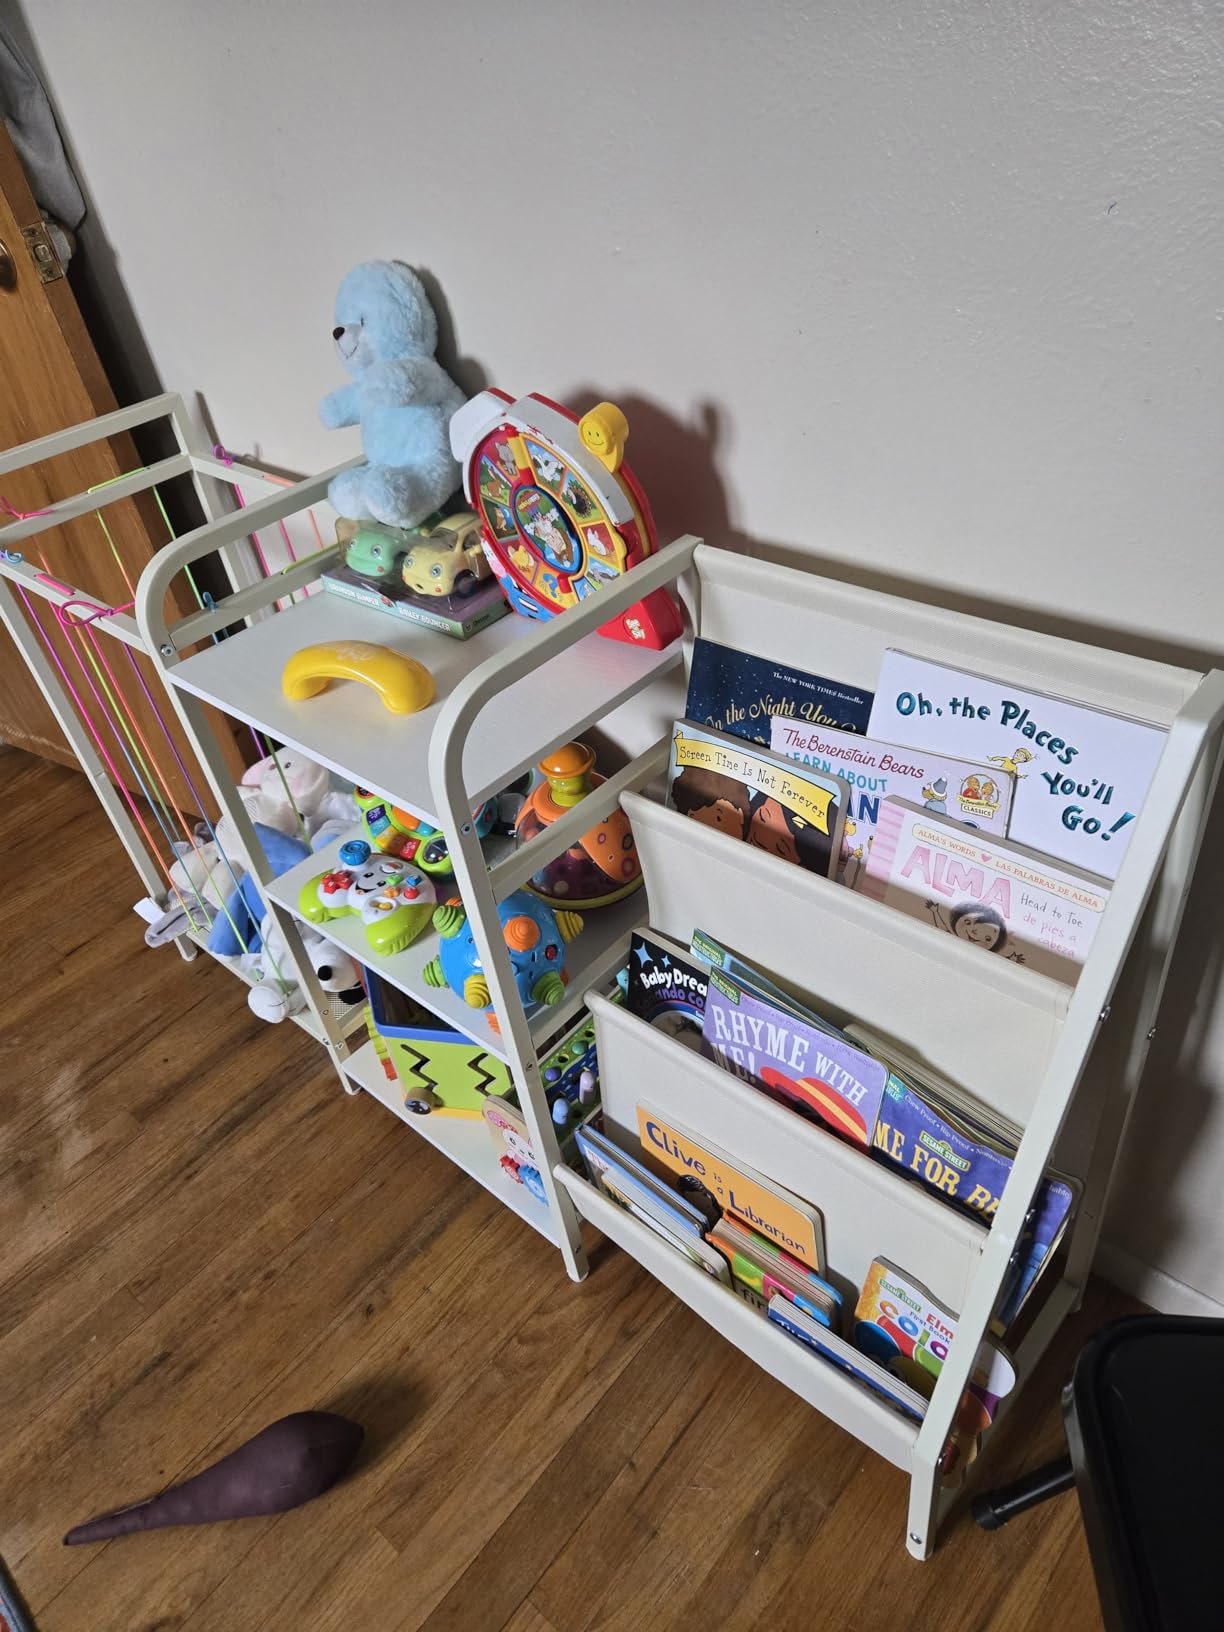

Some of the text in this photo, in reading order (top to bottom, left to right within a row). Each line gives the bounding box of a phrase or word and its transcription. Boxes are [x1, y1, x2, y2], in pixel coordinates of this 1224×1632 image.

[784, 674, 797, 684] NEW
[799, 679, 815, 690] YORK
[817, 685, 837, 696] TIMES
[726, 702, 745, 726] the
[749, 694, 796, 718] Night
[896, 691, 1079, 765] Oh, the Places
[783, 728, 925, 779] The Berenstain Bears
[679, 746, 712, 763] Screen
[715, 751, 739, 772] Time
[742, 761, 753, 776] Is
[757, 768, 776, 789] Not
[780, 780, 825, 818] Forever
[785, 752, 888, 792] EARN ABOUT
[1040, 771, 1114, 805] You'll
[963, 805, 991, 817] CLASSICS
[1061, 804, 1136, 841] Go!
[900, 844, 1011, 920] ALMA
[918, 829, 1099, 909] ALMA'S WORDS LAS PALABRAS DE ALMA
[1021, 892, 1084, 928] Head to Toe
[1023, 913, 1077, 943] de pies a
[1037, 936, 1075, 959] cabeza
[640, 965, 672, 990] Baby
[673, 967, 708, 997] Drea
[688, 991, 704, 1009] co
[711, 1004, 810, 1073] RHYME
[815, 1051, 869, 1106] WITH
[646, 1121, 706, 1176] Clive
[922, 1134, 967, 1169] SESAME STREET
[873, 1120, 1001, 1216] ME FOR BA
[729, 1190, 805, 1255] Librarian
[909, 1311, 951, 1344] First Book
[926, 1313, 954, 1339] Elm
